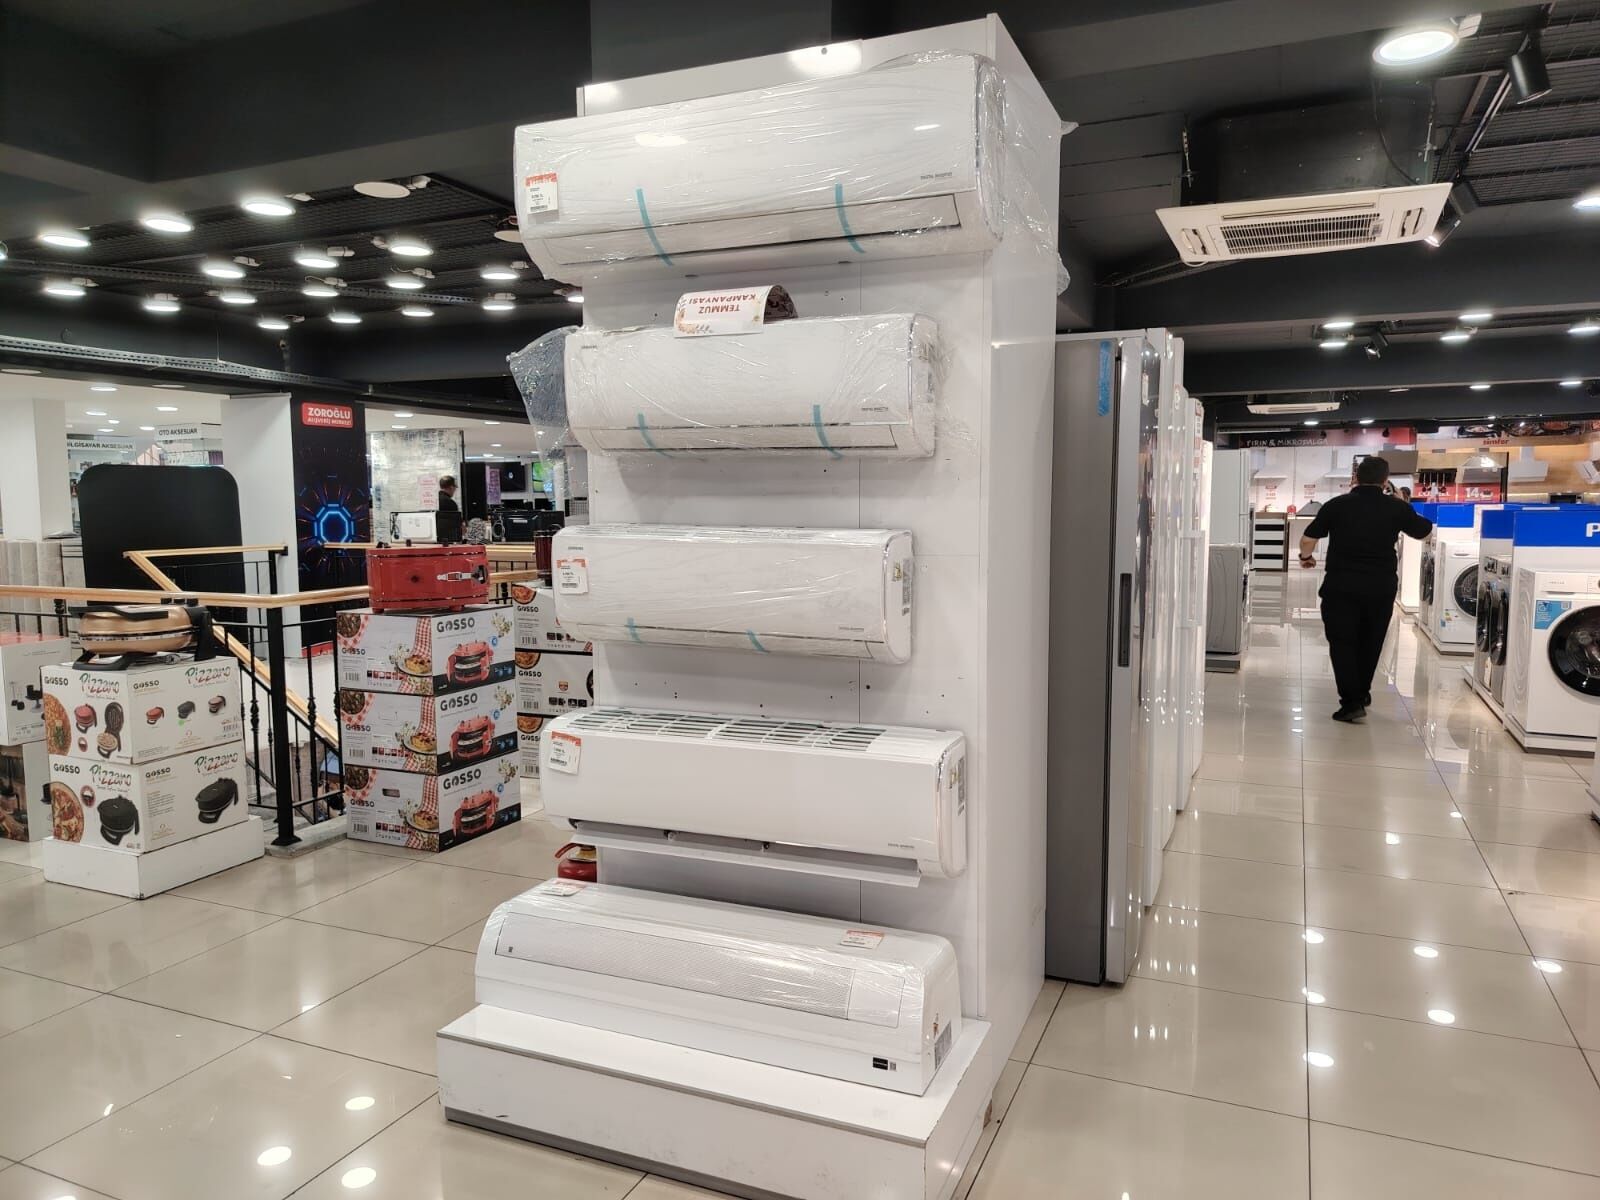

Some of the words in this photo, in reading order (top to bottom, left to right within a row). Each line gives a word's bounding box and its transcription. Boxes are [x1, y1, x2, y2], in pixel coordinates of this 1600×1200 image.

[688, 294, 757, 305] KAMPANYASI
[698, 304, 741, 314] TEMMUZ
[307, 407, 351, 420] ZOROĞLU
[436, 617, 476, 633] GOSSO
[518, 670, 542, 678] GOSSO
[44, 676, 69, 686] GOSSO
[133, 680, 160, 690] GOSSO
[439, 693, 479, 712] GOSSO
[520, 734, 541, 742] GOSS
[53, 763, 81, 775] GOSSO
[145, 767, 171, 778] GOSSO
[442, 768, 482, 790] GOSSO
